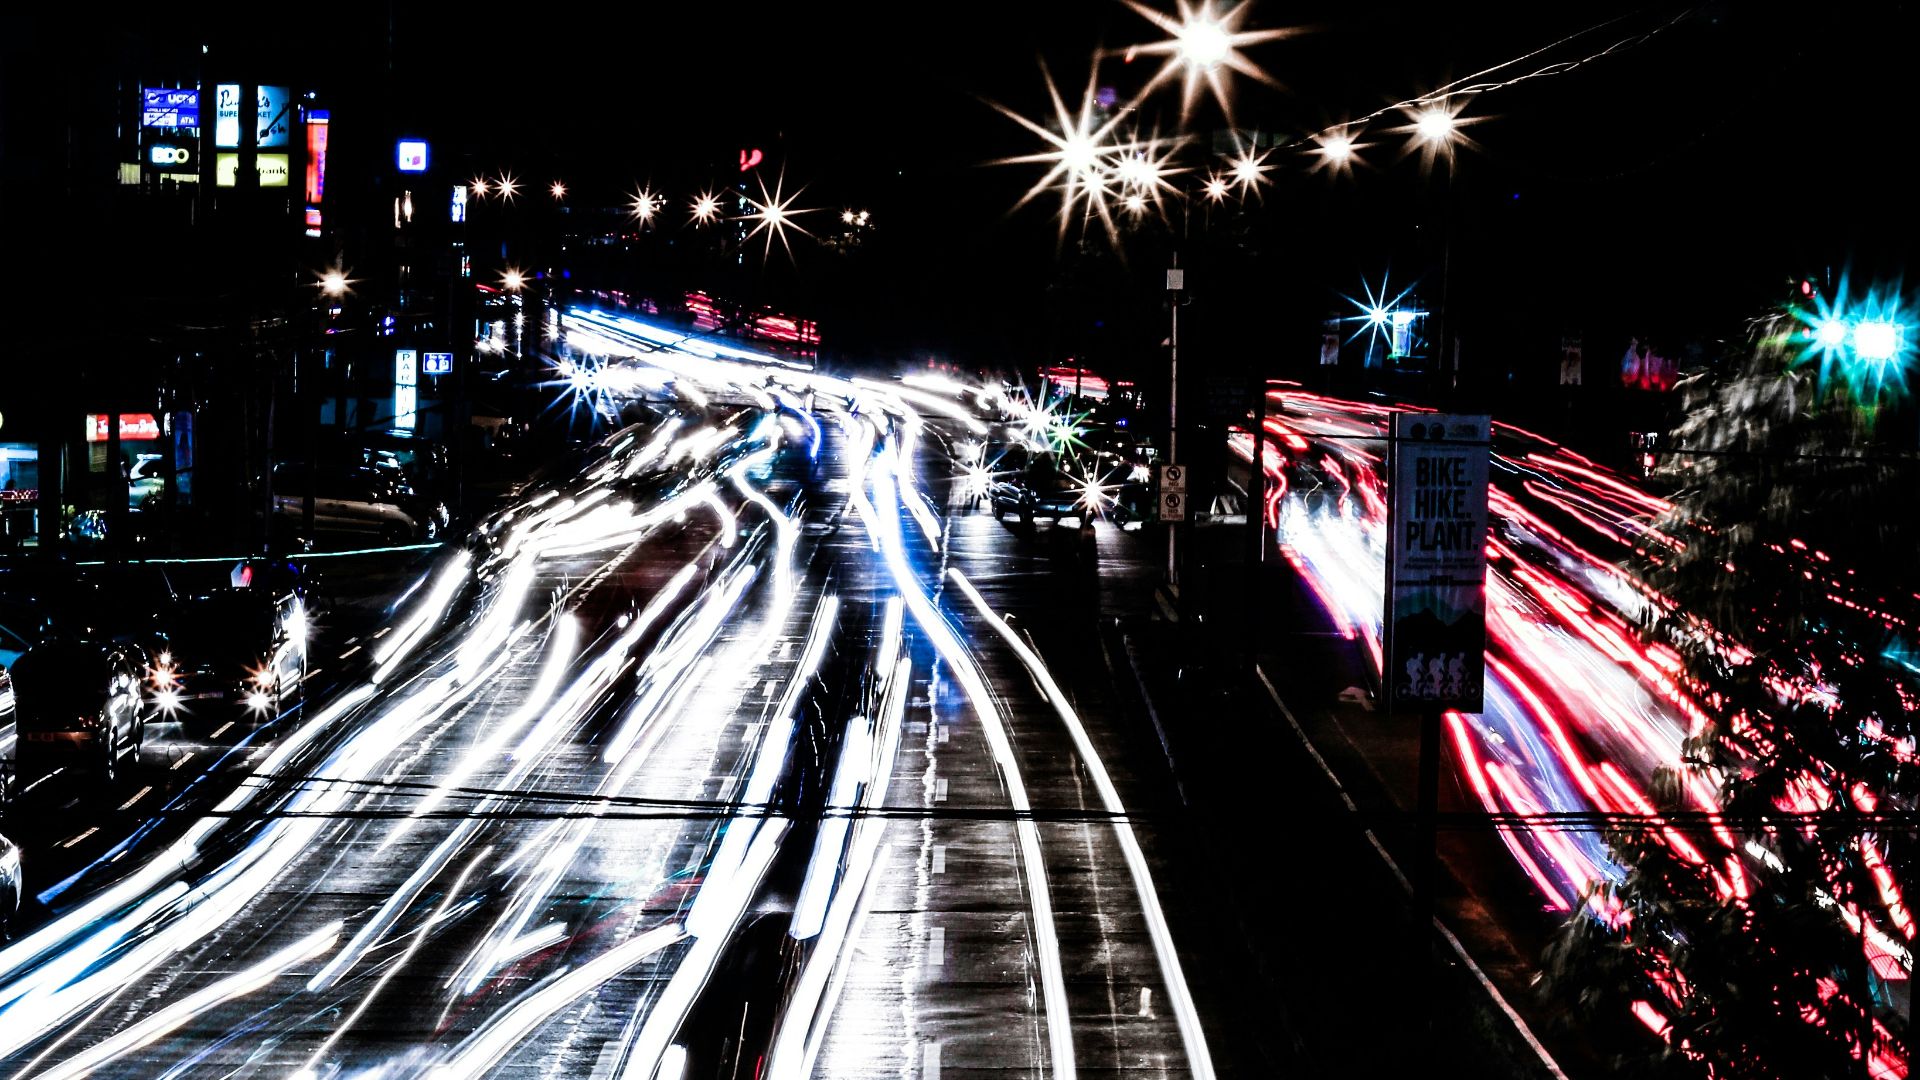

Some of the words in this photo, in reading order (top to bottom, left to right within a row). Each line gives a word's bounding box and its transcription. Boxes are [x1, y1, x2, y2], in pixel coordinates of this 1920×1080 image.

[152, 147, 189, 163] BDO
[1416, 457, 1472, 486] BIKE.
[1415, 490, 1471, 518] HIKE.
[1406, 521, 1479, 550] PLANT.
